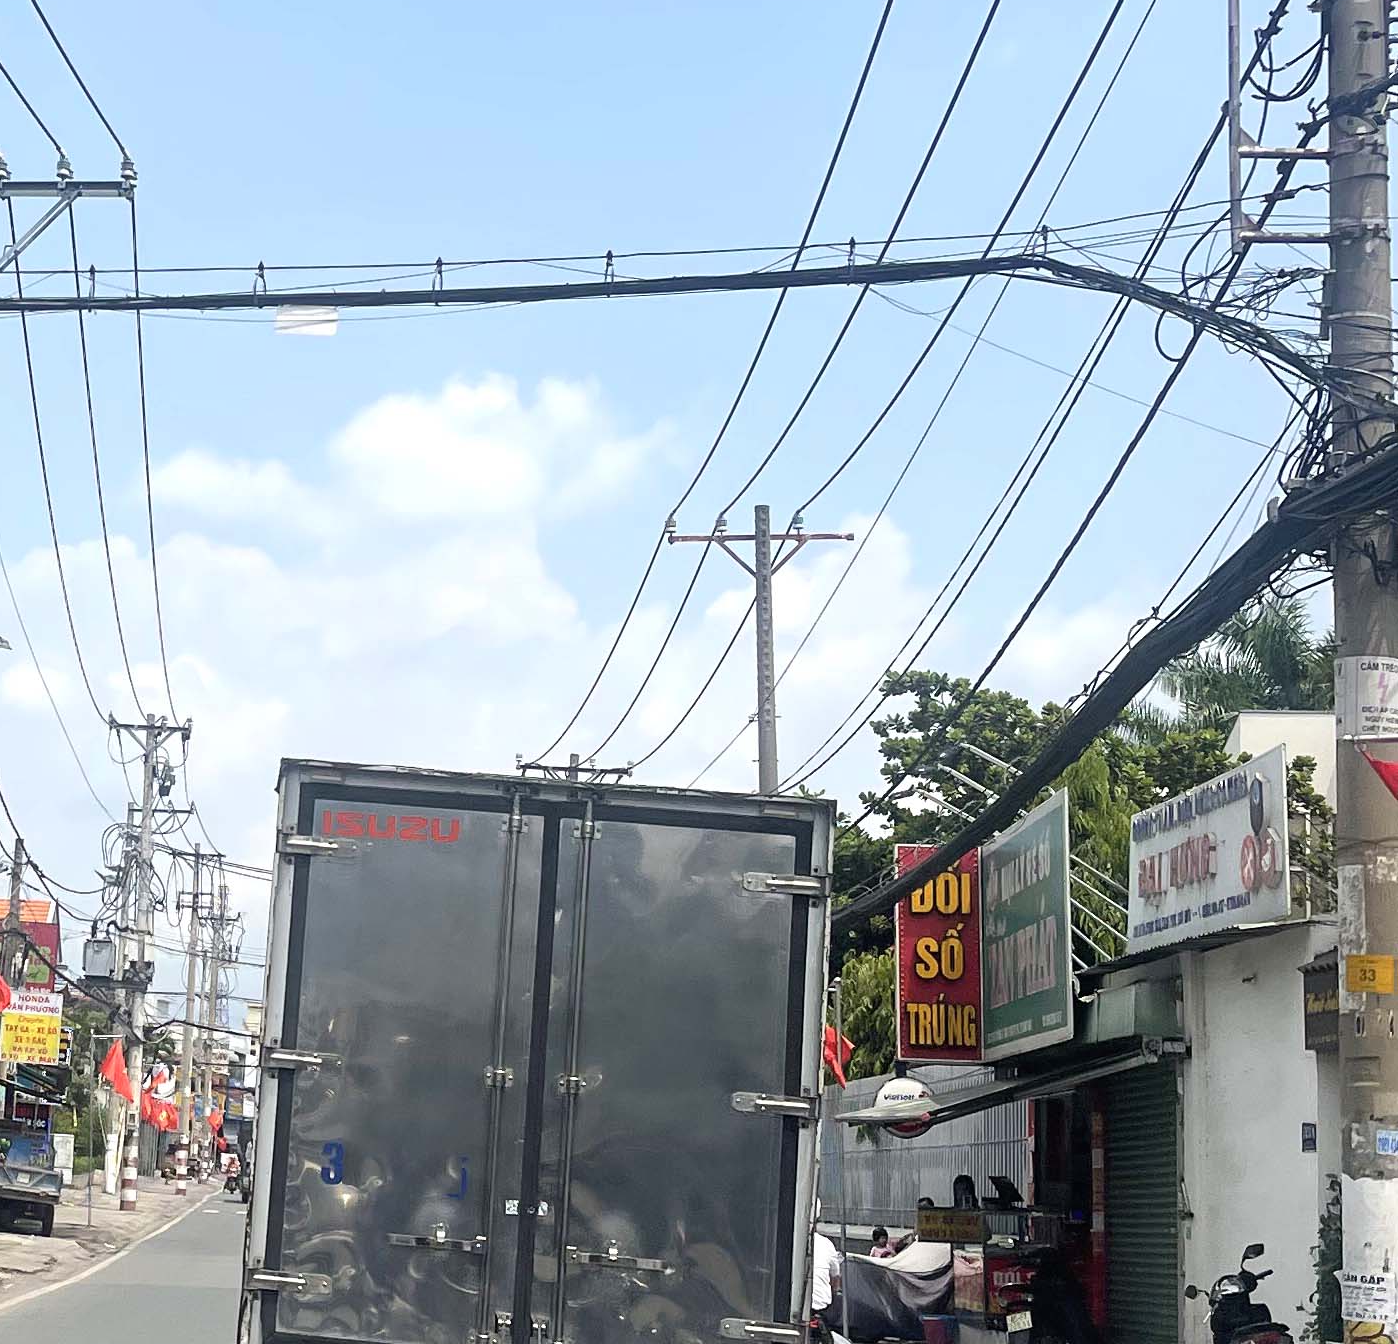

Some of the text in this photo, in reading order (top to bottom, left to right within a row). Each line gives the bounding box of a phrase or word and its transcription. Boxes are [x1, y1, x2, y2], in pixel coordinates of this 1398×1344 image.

[322, 809, 461, 843] ISUZU
[915, 922, 965, 980] SỐ
[1359, 968, 1377, 982] 33
[18, 995, 50, 1003] HONDA
[906, 993, 977, 1047] TRÚNG
[321, 1138, 345, 1185] 3
